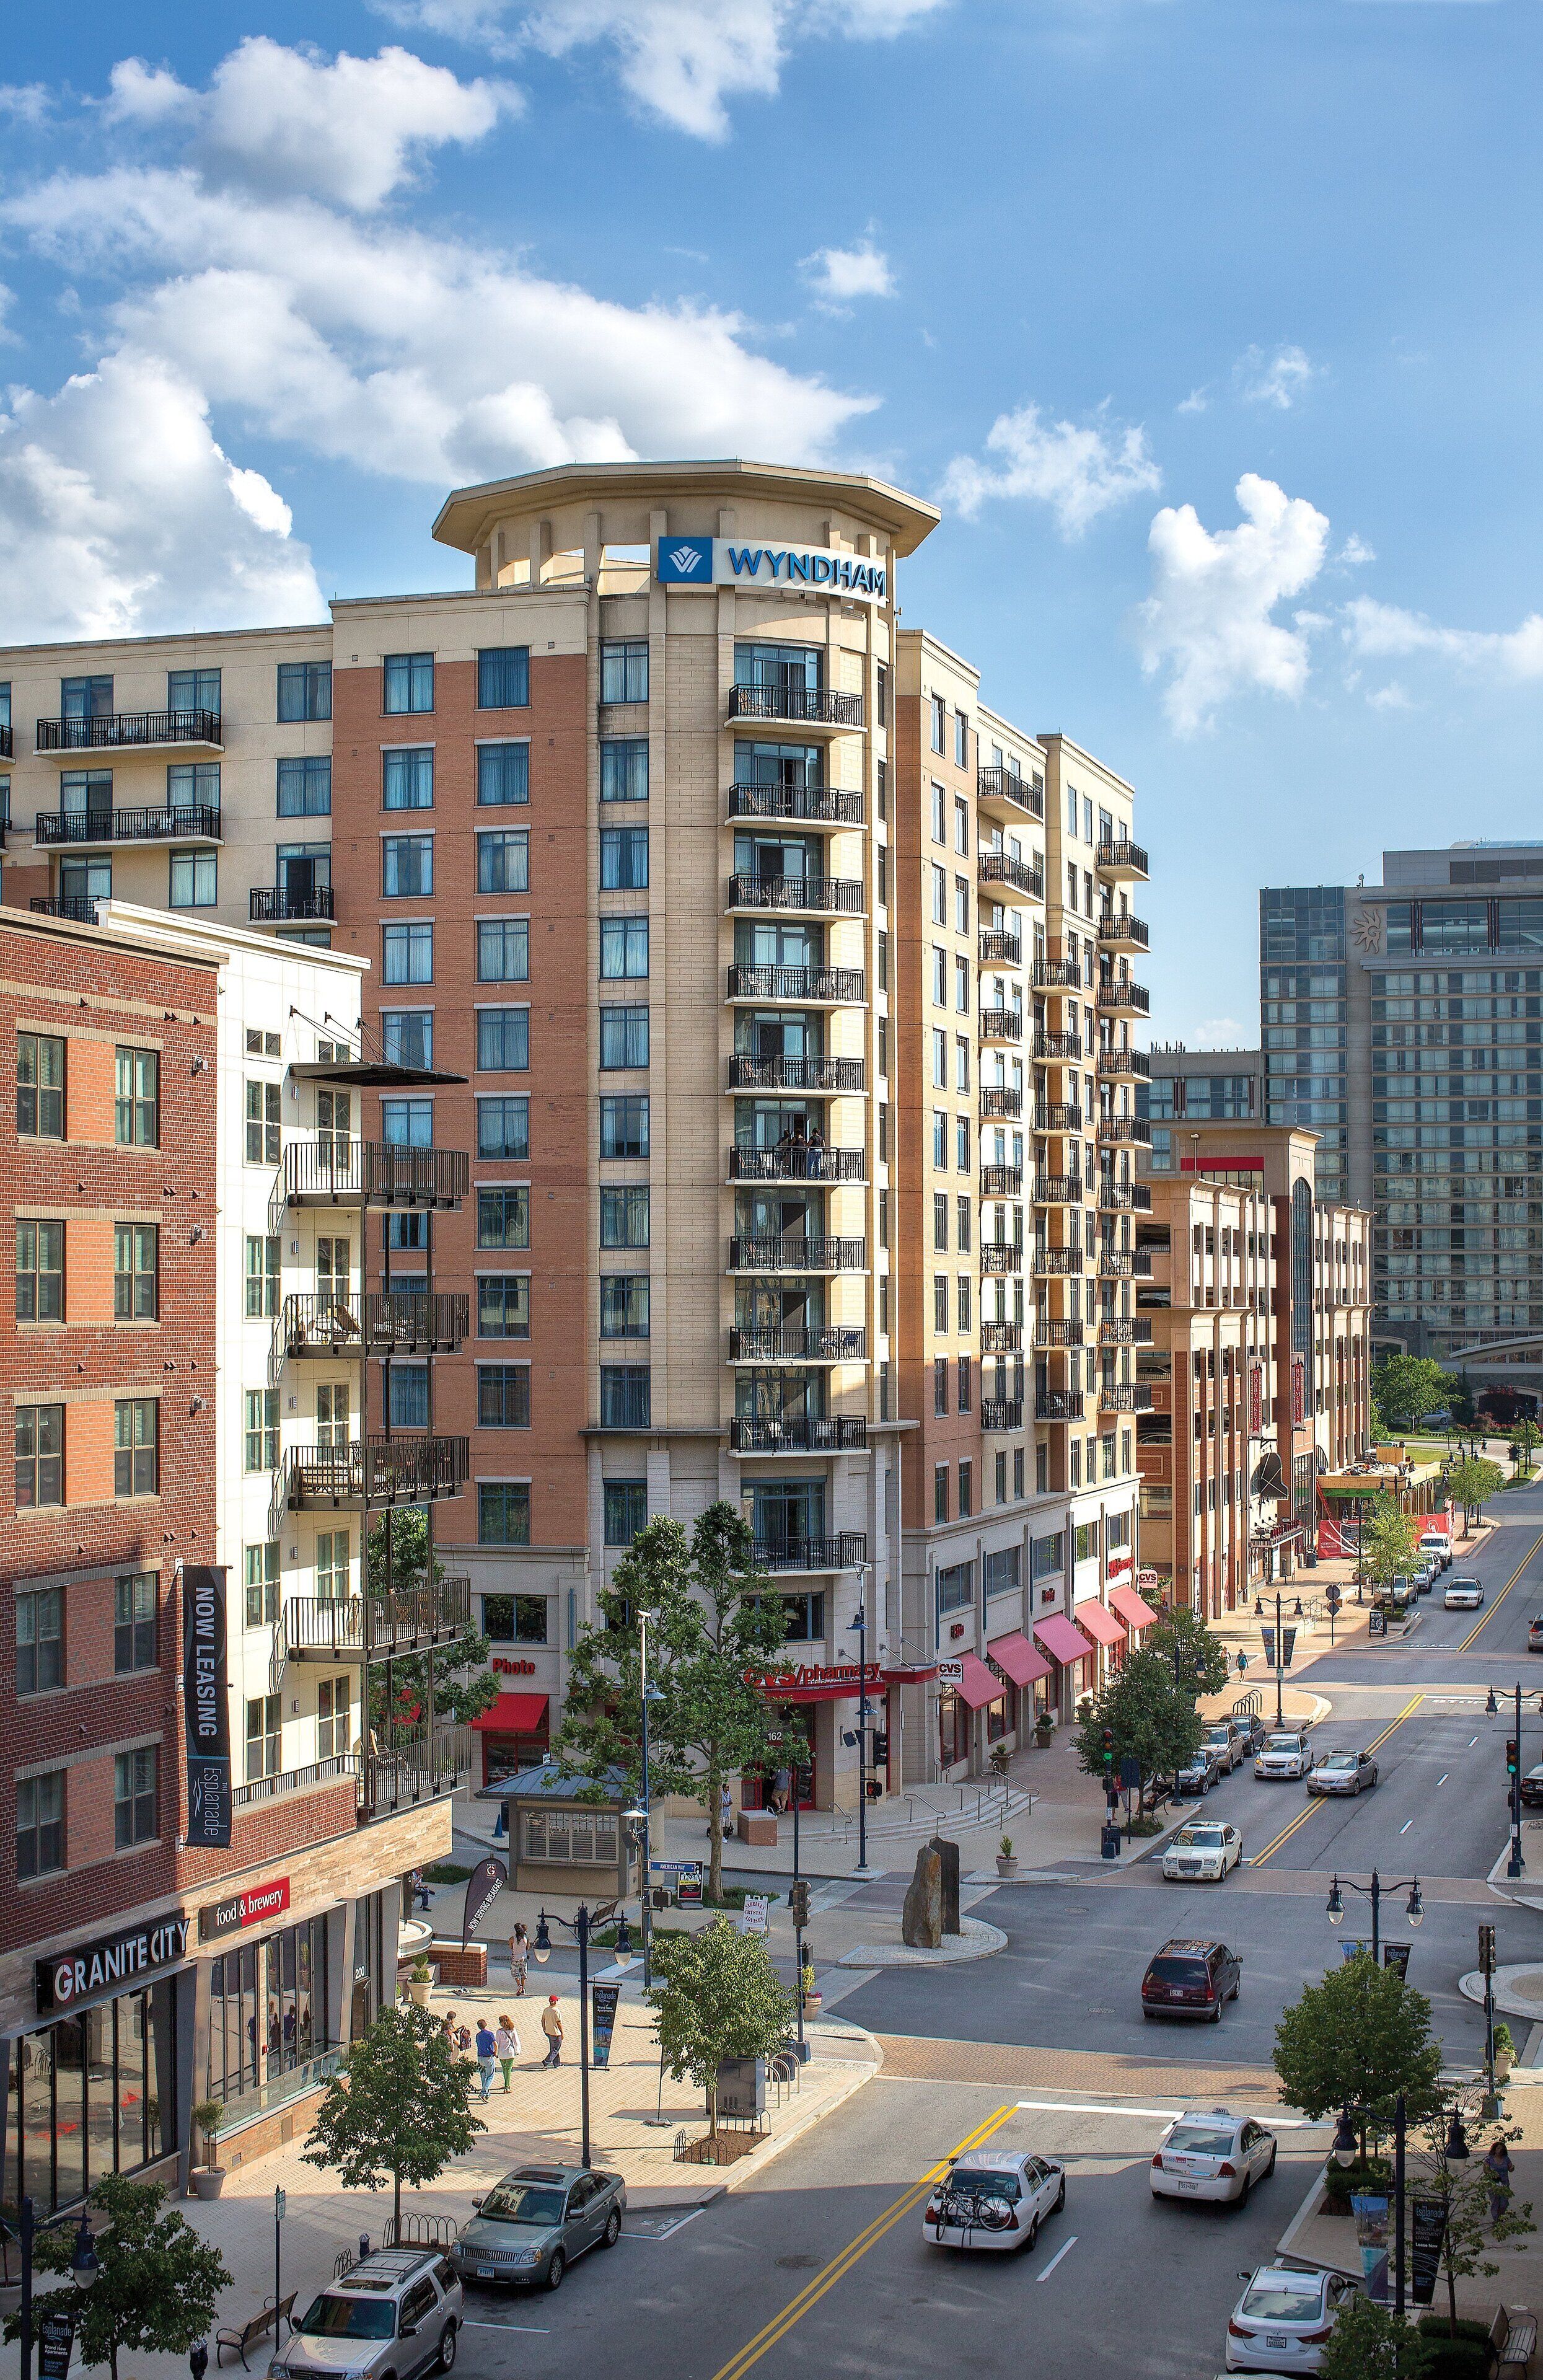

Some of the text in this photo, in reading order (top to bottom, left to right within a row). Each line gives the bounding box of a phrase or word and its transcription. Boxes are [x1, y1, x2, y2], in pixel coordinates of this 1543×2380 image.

[728, 547, 886, 597] WYNDHAM
[196, 1587, 217, 1736] NOW LEASING
[493, 1658, 535, 1675] Photo
[939, 1664, 961, 1673] CVS
[767, 1732, 782, 1740] 162
[200, 1768, 228, 1836] Esplanade
[216, 1889, 283, 1926] food & brewery
[467, 1918, 480, 1931] NOW
[476, 1900, 491, 1920] SERVING
[485, 1878, 504, 1903] BREAKFAST
[55, 1918, 190, 2001] GRANITE CITY
[355, 1965, 365, 1980] 200
[595, 1990, 617, 1999] Esplanade
[1416, 2207, 1444, 2218] Esplanade
[42, 2322, 72, 2337] Esplanade
